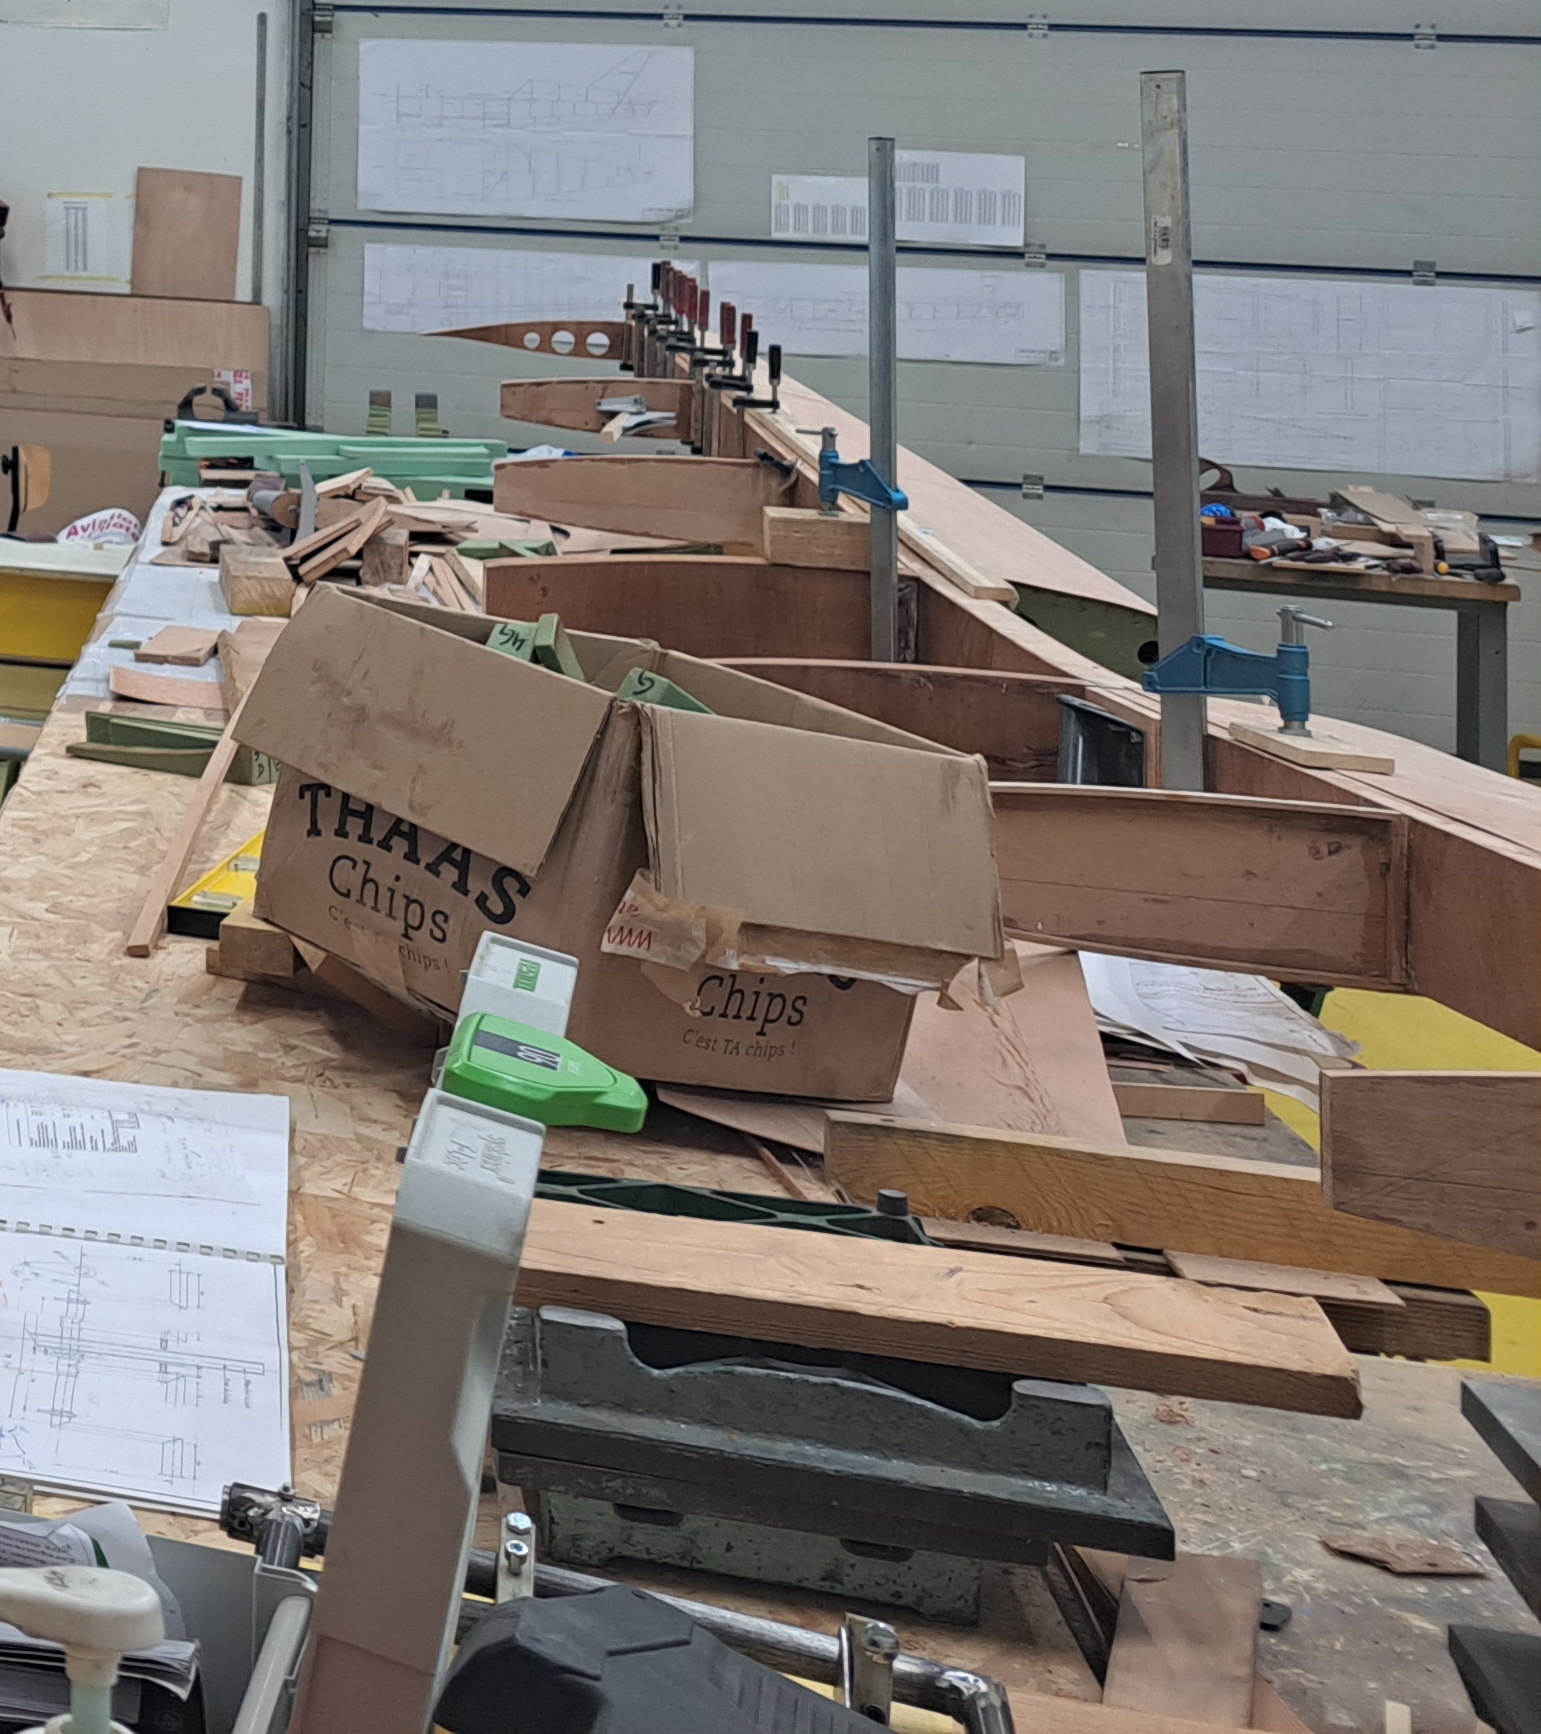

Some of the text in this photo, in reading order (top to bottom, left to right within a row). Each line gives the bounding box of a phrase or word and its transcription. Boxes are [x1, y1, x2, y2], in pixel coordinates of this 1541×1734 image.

[299, 782, 531, 925] THAAS
[328, 854, 449, 943] Chips
[696, 973, 808, 1037] Chips
[682, 1028, 717, 1050] C'est
[723, 1039, 740, 1056] TA
[745, 1042, 785, 1062] chips
